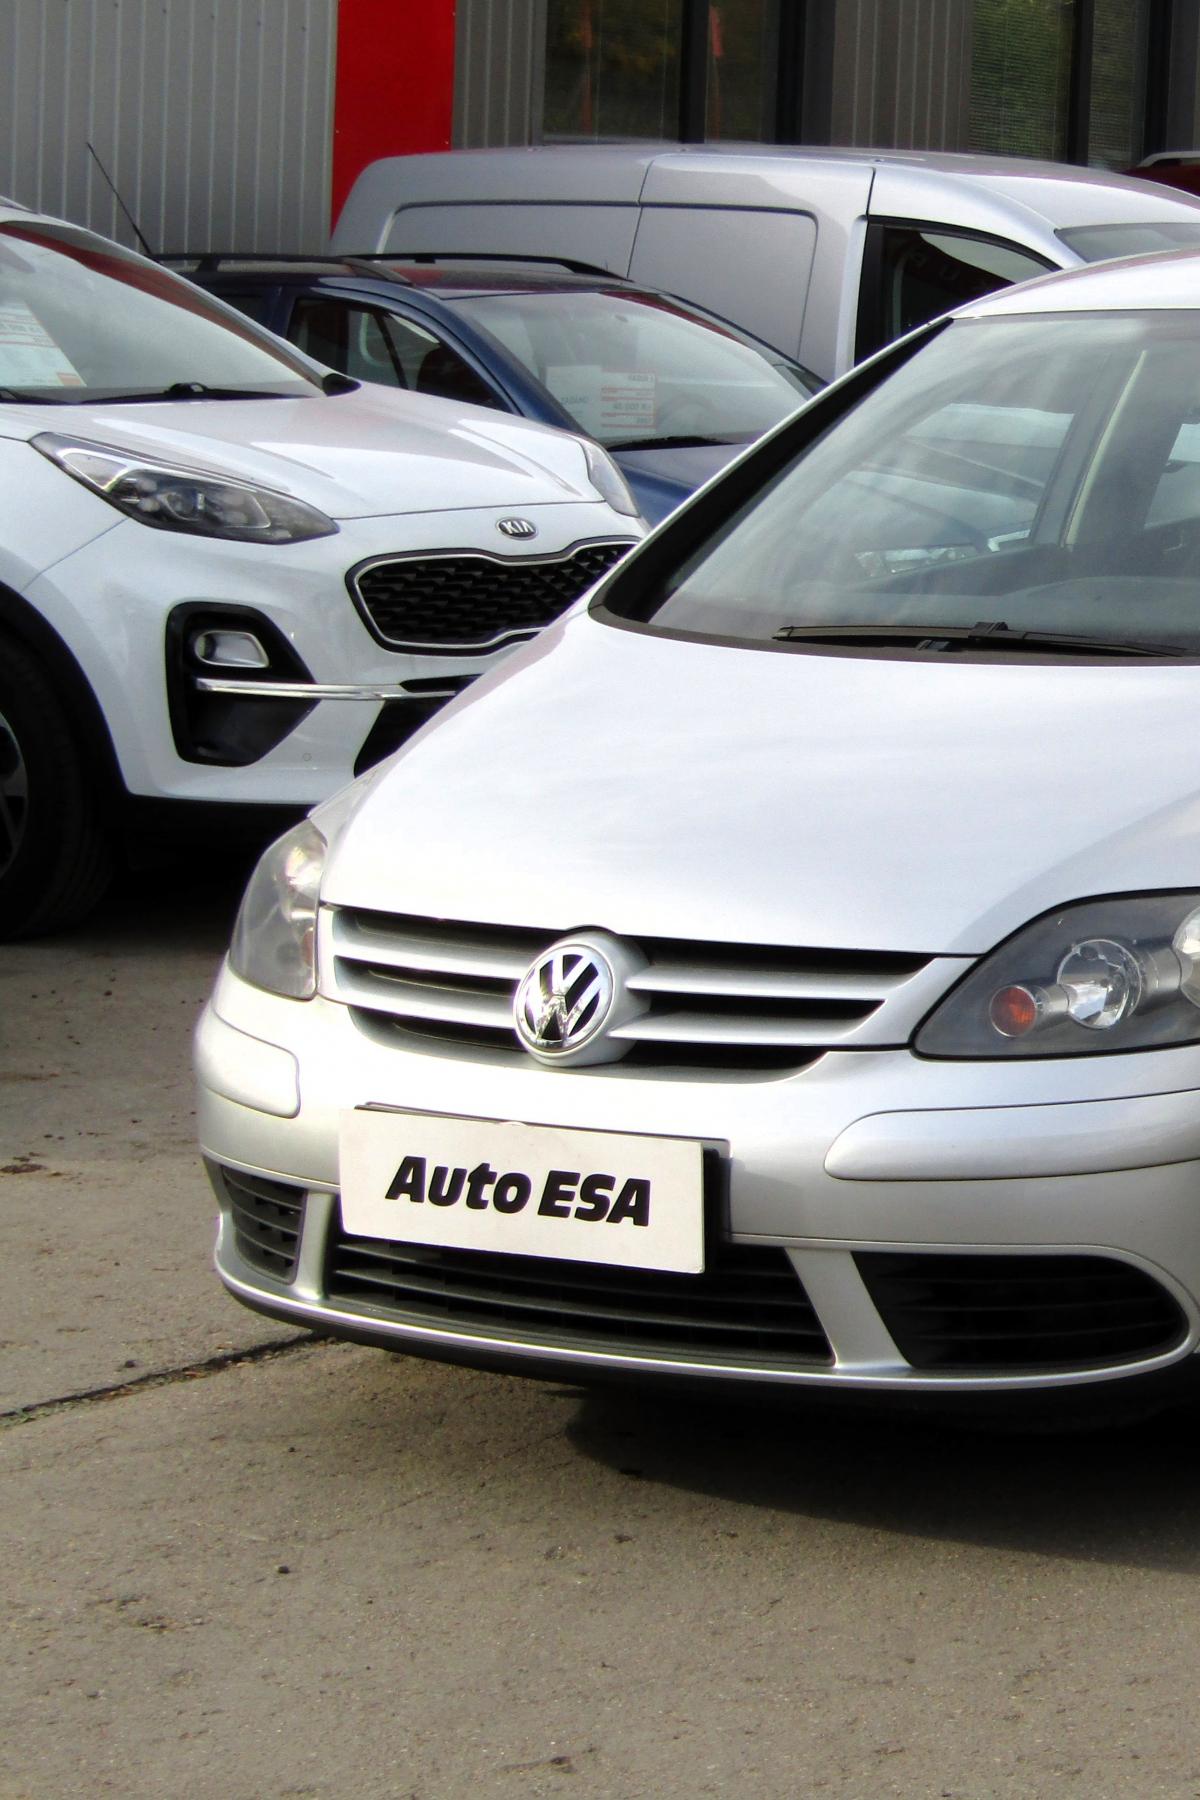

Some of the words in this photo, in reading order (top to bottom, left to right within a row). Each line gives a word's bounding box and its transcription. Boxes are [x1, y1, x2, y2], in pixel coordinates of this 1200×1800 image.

[501, 520, 535, 534] KIA
[385, 1155, 532, 1214] Auto
[537, 1170, 651, 1227] ESA
